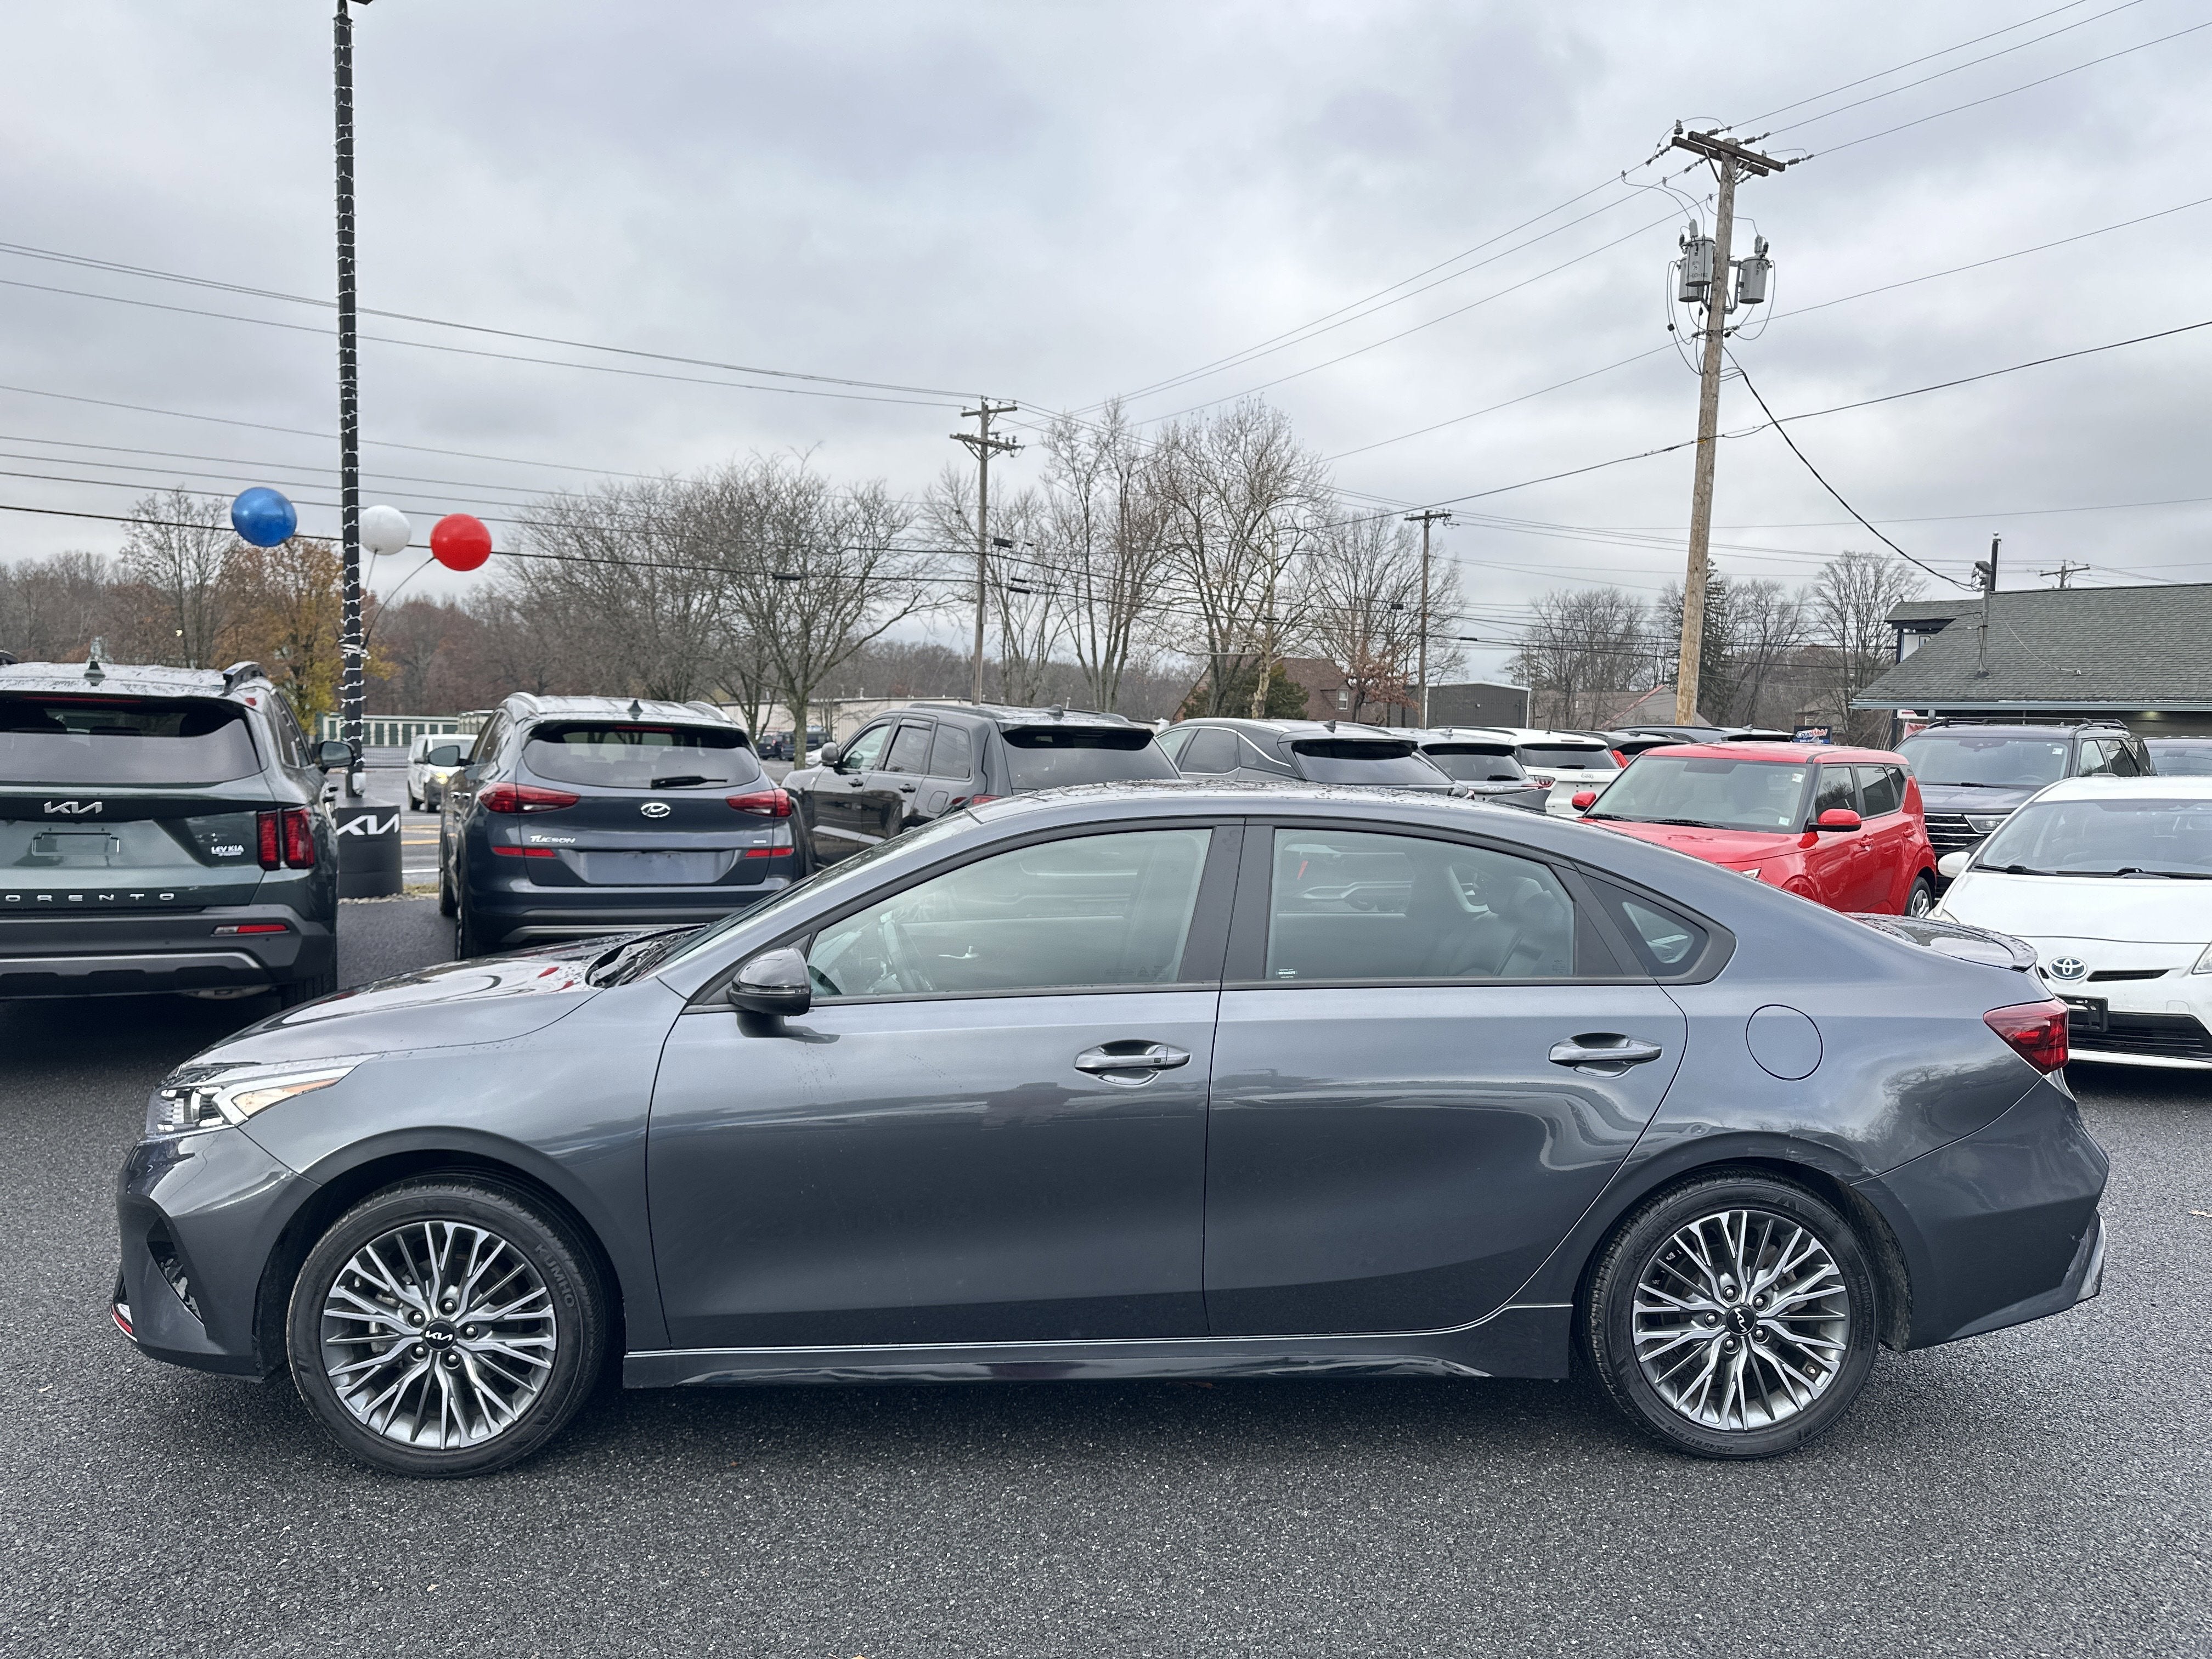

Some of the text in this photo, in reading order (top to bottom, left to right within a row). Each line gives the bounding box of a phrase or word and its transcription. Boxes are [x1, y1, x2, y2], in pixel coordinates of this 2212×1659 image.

[44, 801, 103, 814] KIA
[535, 1244, 575, 1307] KUMHO
[425, 1330, 453, 1341] KIA
[1666, 1426, 1734, 1453] 225/45 R17 91W
